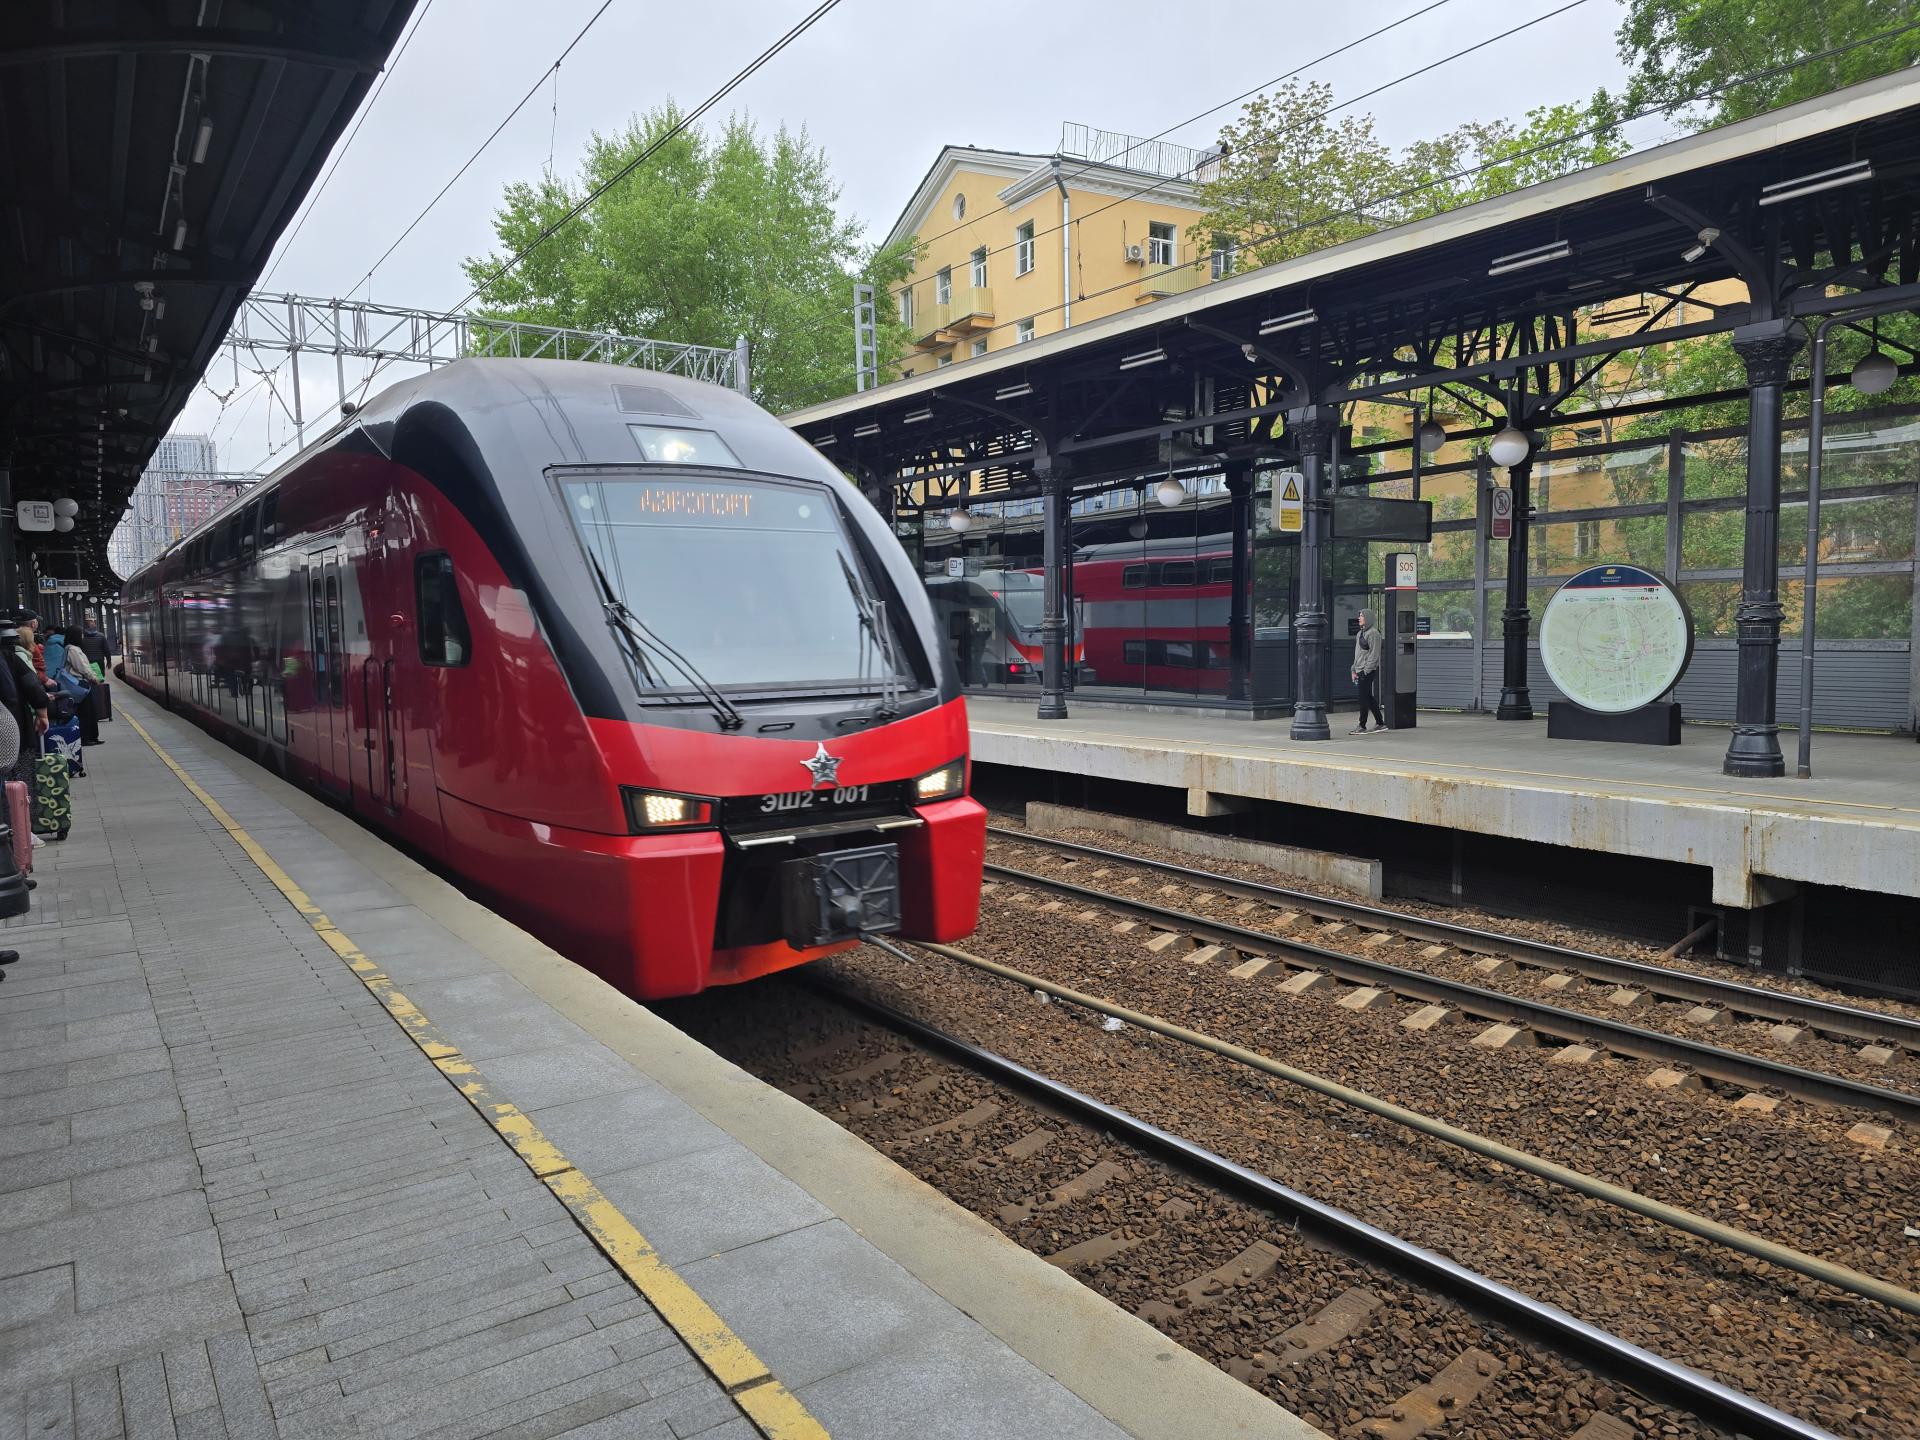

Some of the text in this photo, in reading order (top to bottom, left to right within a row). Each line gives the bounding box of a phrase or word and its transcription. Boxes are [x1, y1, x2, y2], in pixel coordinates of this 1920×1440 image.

[1399, 561, 1414, 572] SOS
[42, 579, 54, 587] 14
[760, 790, 814, 812] ЭШ2
[833, 785, 869, 804] 001
